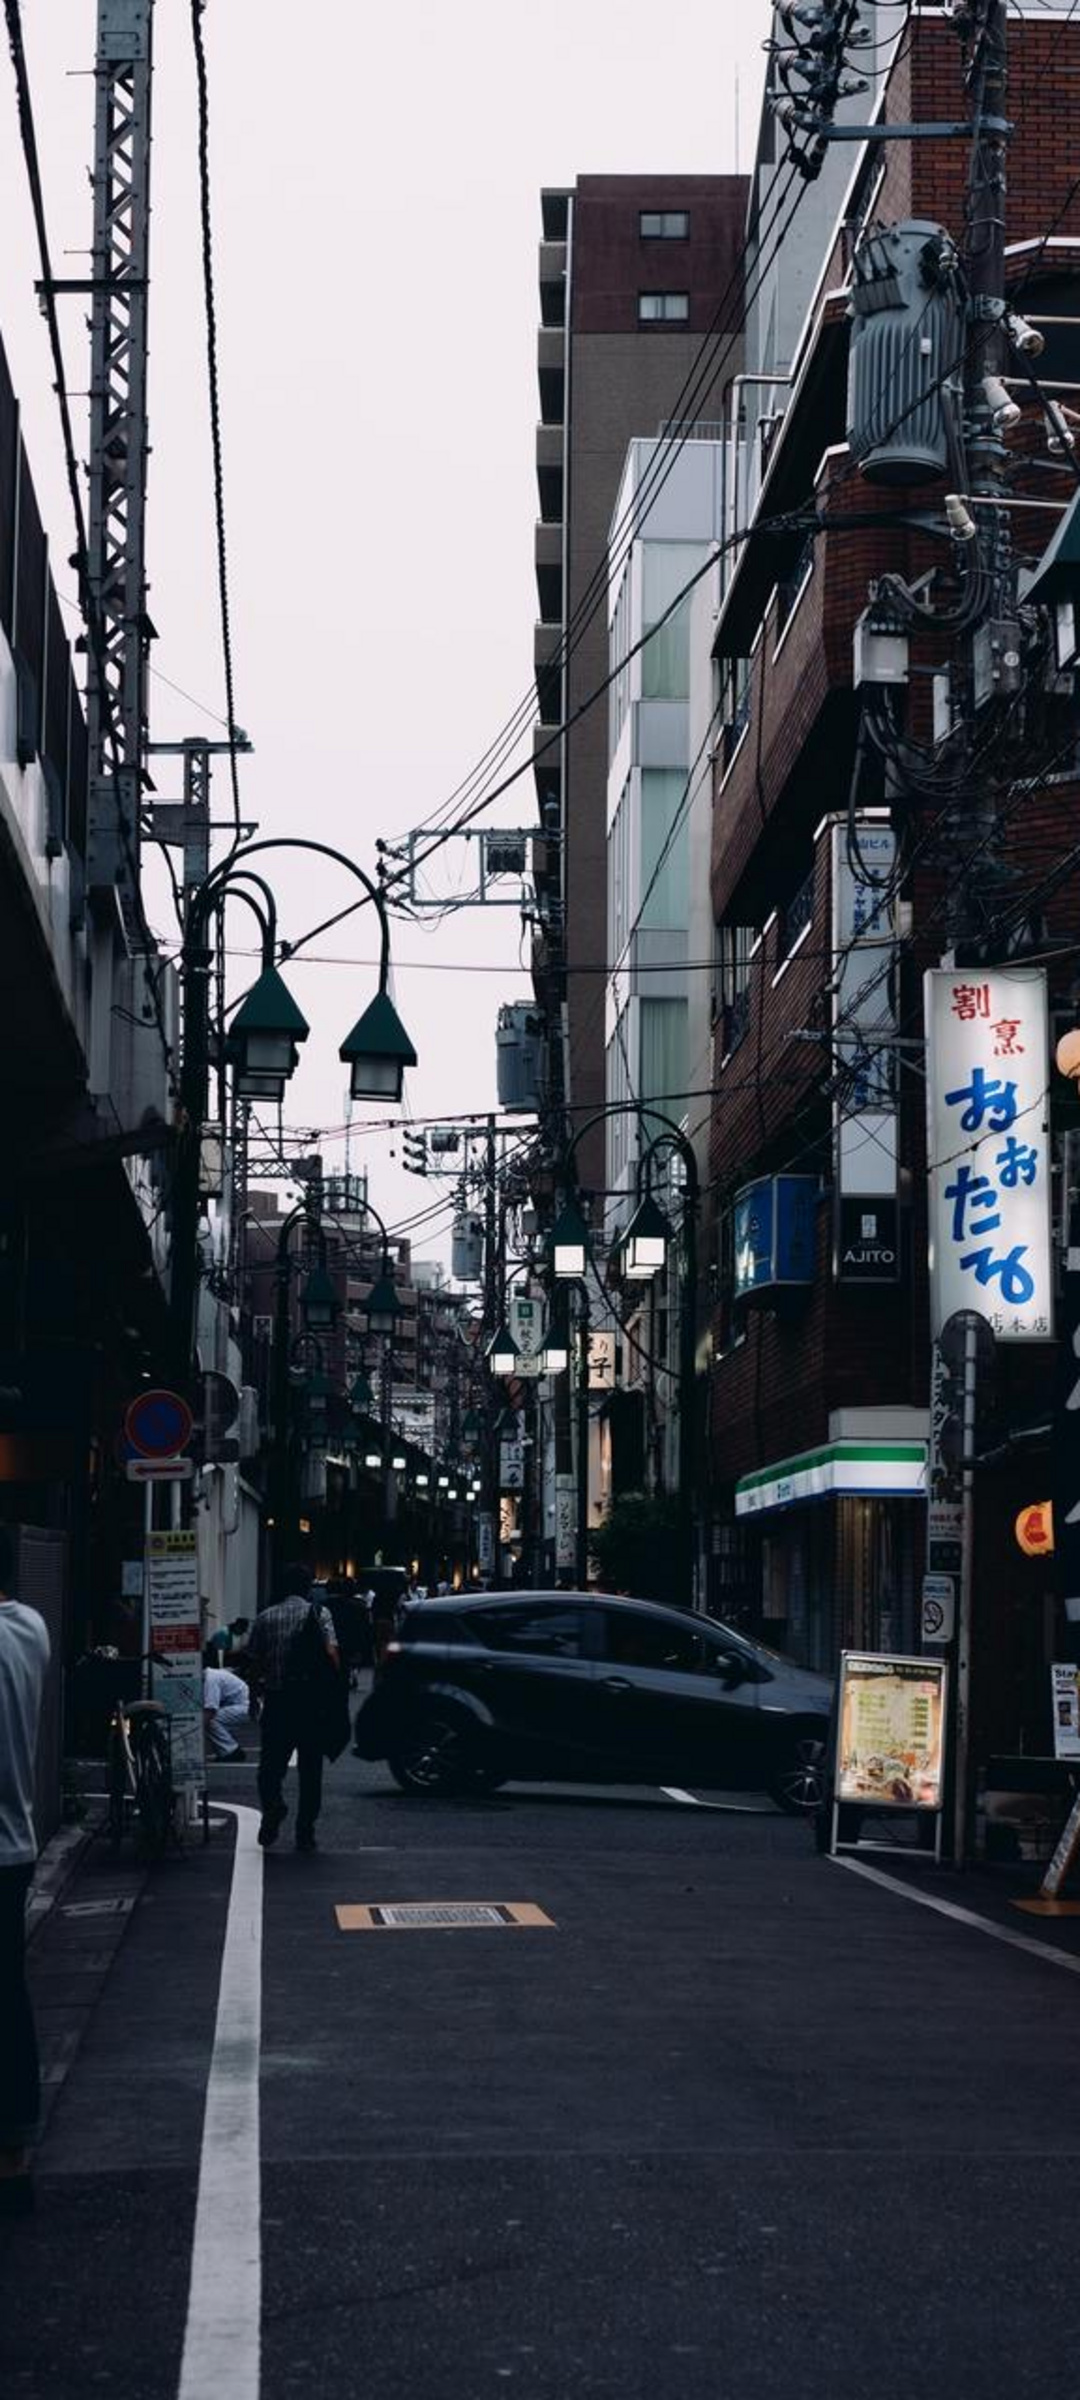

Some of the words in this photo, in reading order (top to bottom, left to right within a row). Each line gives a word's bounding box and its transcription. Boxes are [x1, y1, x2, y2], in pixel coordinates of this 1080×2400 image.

[845, 838, 889, 850] 山ビル
[951, 984, 1025, 1056] 割烹
[842, 1249, 895, 1264] AJITO
